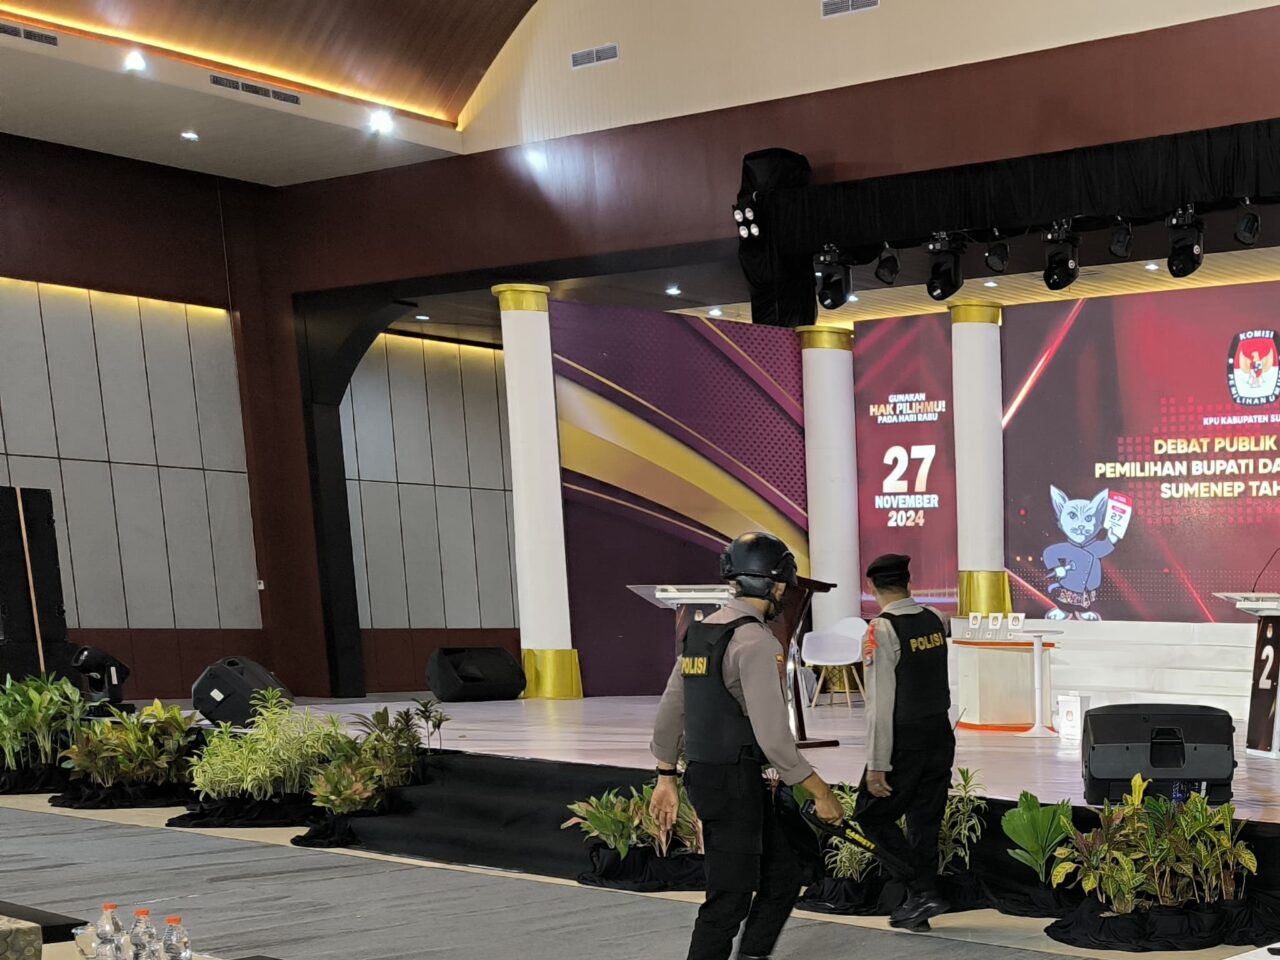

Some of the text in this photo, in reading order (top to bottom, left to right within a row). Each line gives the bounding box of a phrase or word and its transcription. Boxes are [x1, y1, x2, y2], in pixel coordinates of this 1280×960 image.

[1239, 330, 1275, 341] KOMISI
[888, 392, 926, 403] GUNAKAN
[1228, 374, 1266, 404] PEMILIHAN
[869, 400, 946, 416] HAK PILIHMU!
[877, 413, 938, 424] PADA HARI RABU
[1203, 417, 1220, 425] KPU
[1220, 414, 1269, 424] KABUPATEN
[1153, 438, 1210, 455] DEBAT
[1214, 435, 1277, 453] PUBLIK
[882, 444, 936, 493] 27
[1094, 461, 1188, 478] PEMILIHAN
[1191, 458, 1254, 476] BUPATI
[1160, 482, 1245, 498] SUMENEP
[875, 494, 939, 509] NOVEMBER
[887, 510, 925, 527] 2024
[909, 632, 944, 653] POLISI
[681, 656, 707, 675] POLISI
[1258, 645, 1275, 690] 2
